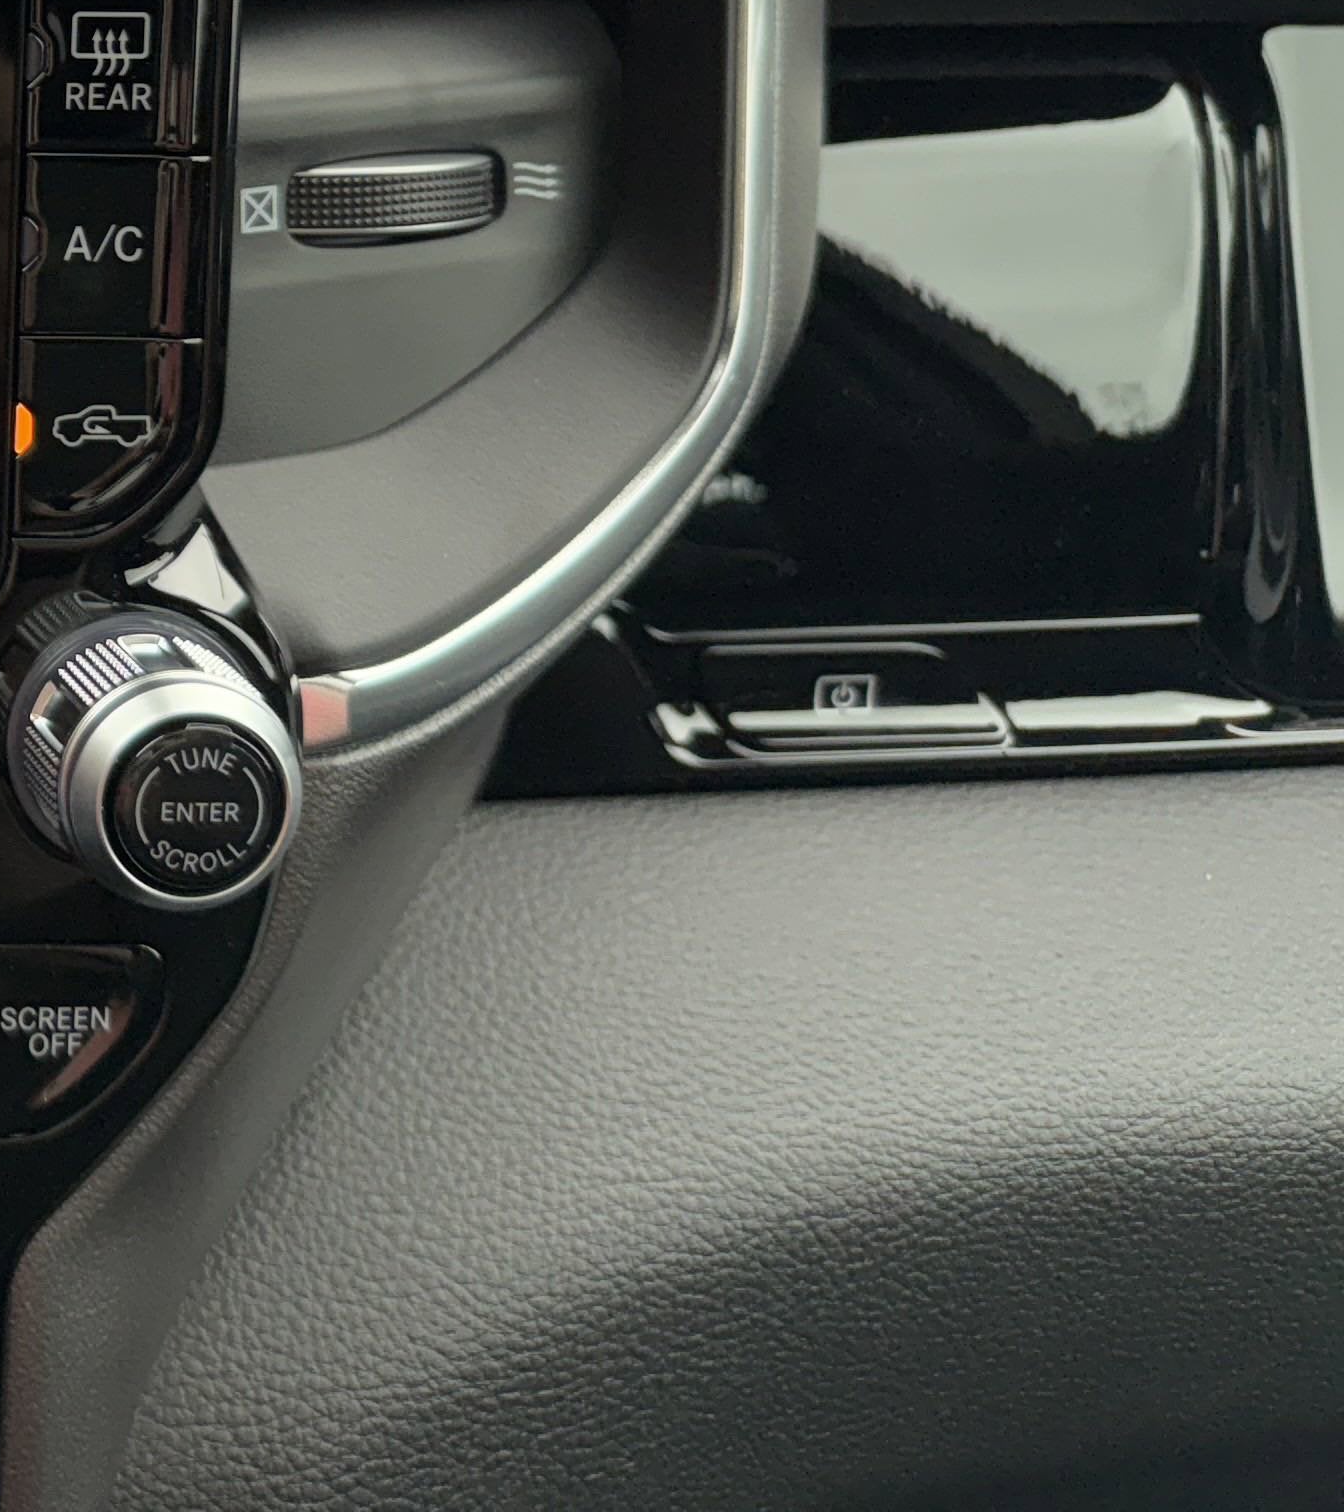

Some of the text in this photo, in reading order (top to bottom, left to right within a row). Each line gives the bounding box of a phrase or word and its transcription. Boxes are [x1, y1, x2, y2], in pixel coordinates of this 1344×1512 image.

[65, 83, 152, 111] REAR
[63, 224, 144, 263] A/C
[164, 747, 240, 778] TUNE
[160, 801, 241, 824] ENTER
[149, 838, 247, 875] SCROLL
[0, 1006, 112, 1033] SCREEN
[29, 1032, 83, 1059] OFF
